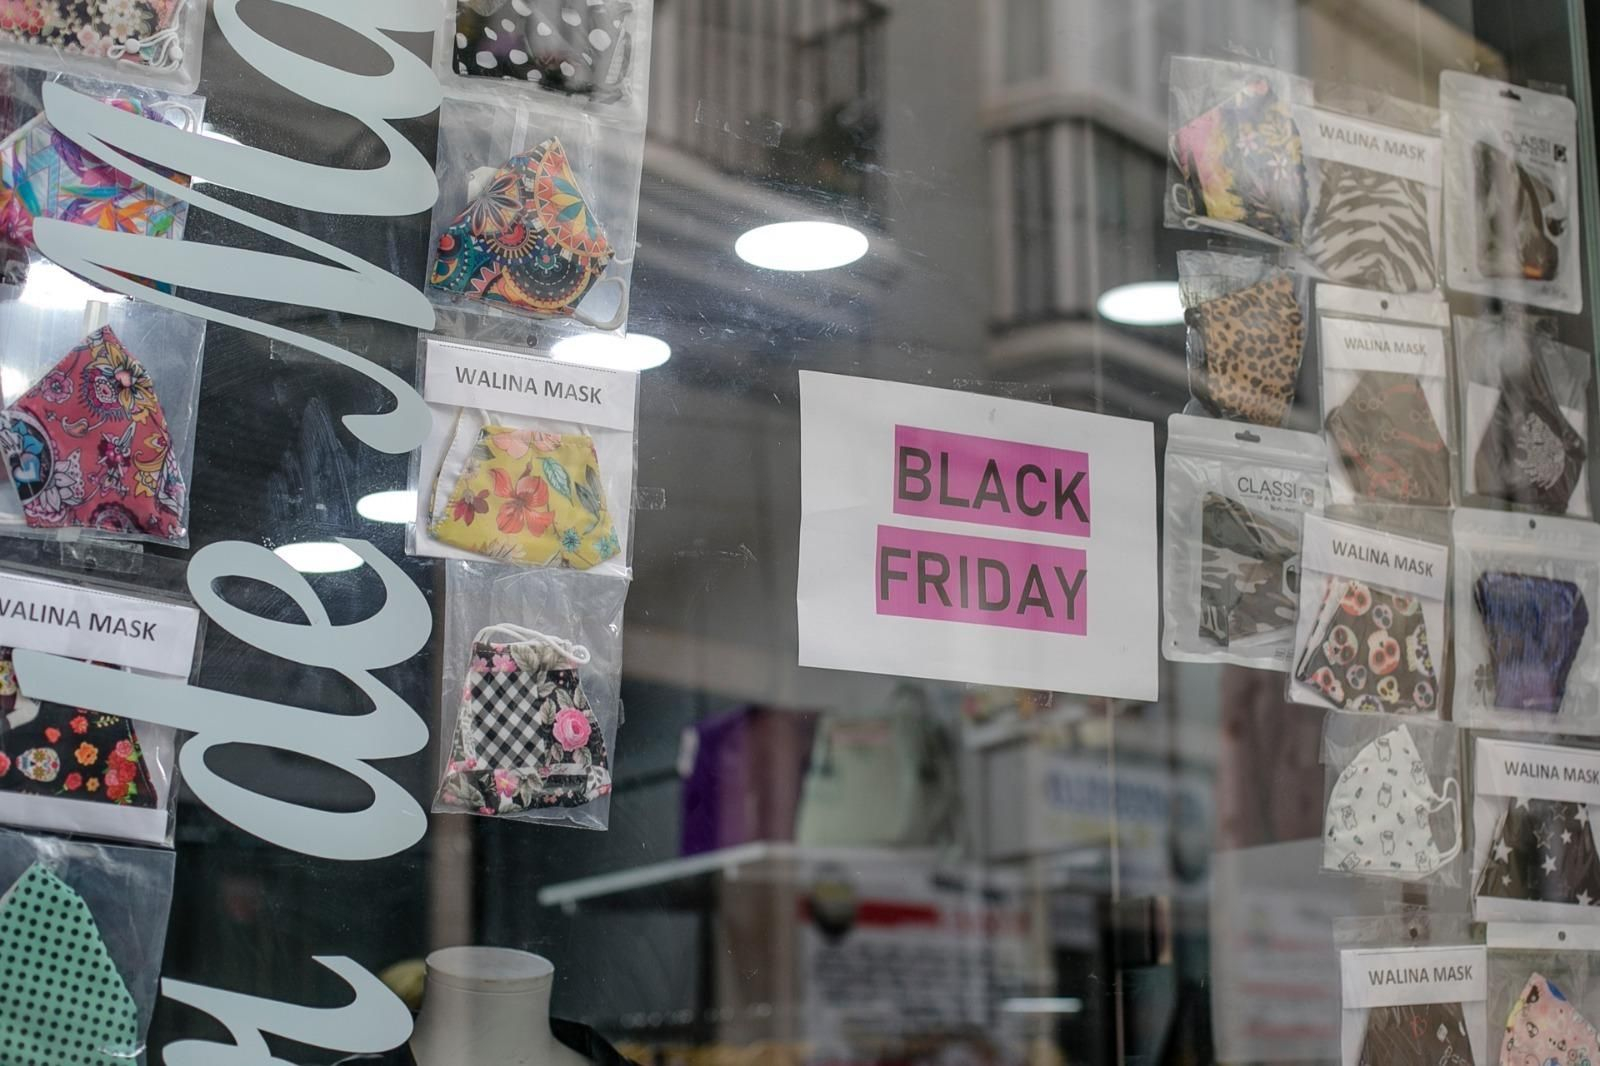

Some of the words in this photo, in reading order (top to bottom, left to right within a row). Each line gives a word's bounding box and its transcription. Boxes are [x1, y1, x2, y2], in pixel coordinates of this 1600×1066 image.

[1319, 123, 1380, 152] WALINA
[1384, 140, 1427, 163] MASK
[1343, 336, 1392, 353] WALINA
[1393, 341, 1427, 356] MASK
[456, 366, 538, 396] WALINA
[544, 380, 602, 405] MASK
[898, 446, 1089, 523] BLACK
[1332, 540, 1390, 567] WALINA
[1394, 555, 1434, 577] MASK
[879, 546, 1087, 620] FRIDAY
[89, 612, 157, 642] MASK
[11, 538, 433, 861] de
[1504, 760, 1560, 780] WALINA
[1563, 766, 1600, 785] MASK
[1368, 968, 1430, 986] WALINA
[1433, 965, 1473, 982] MASK
